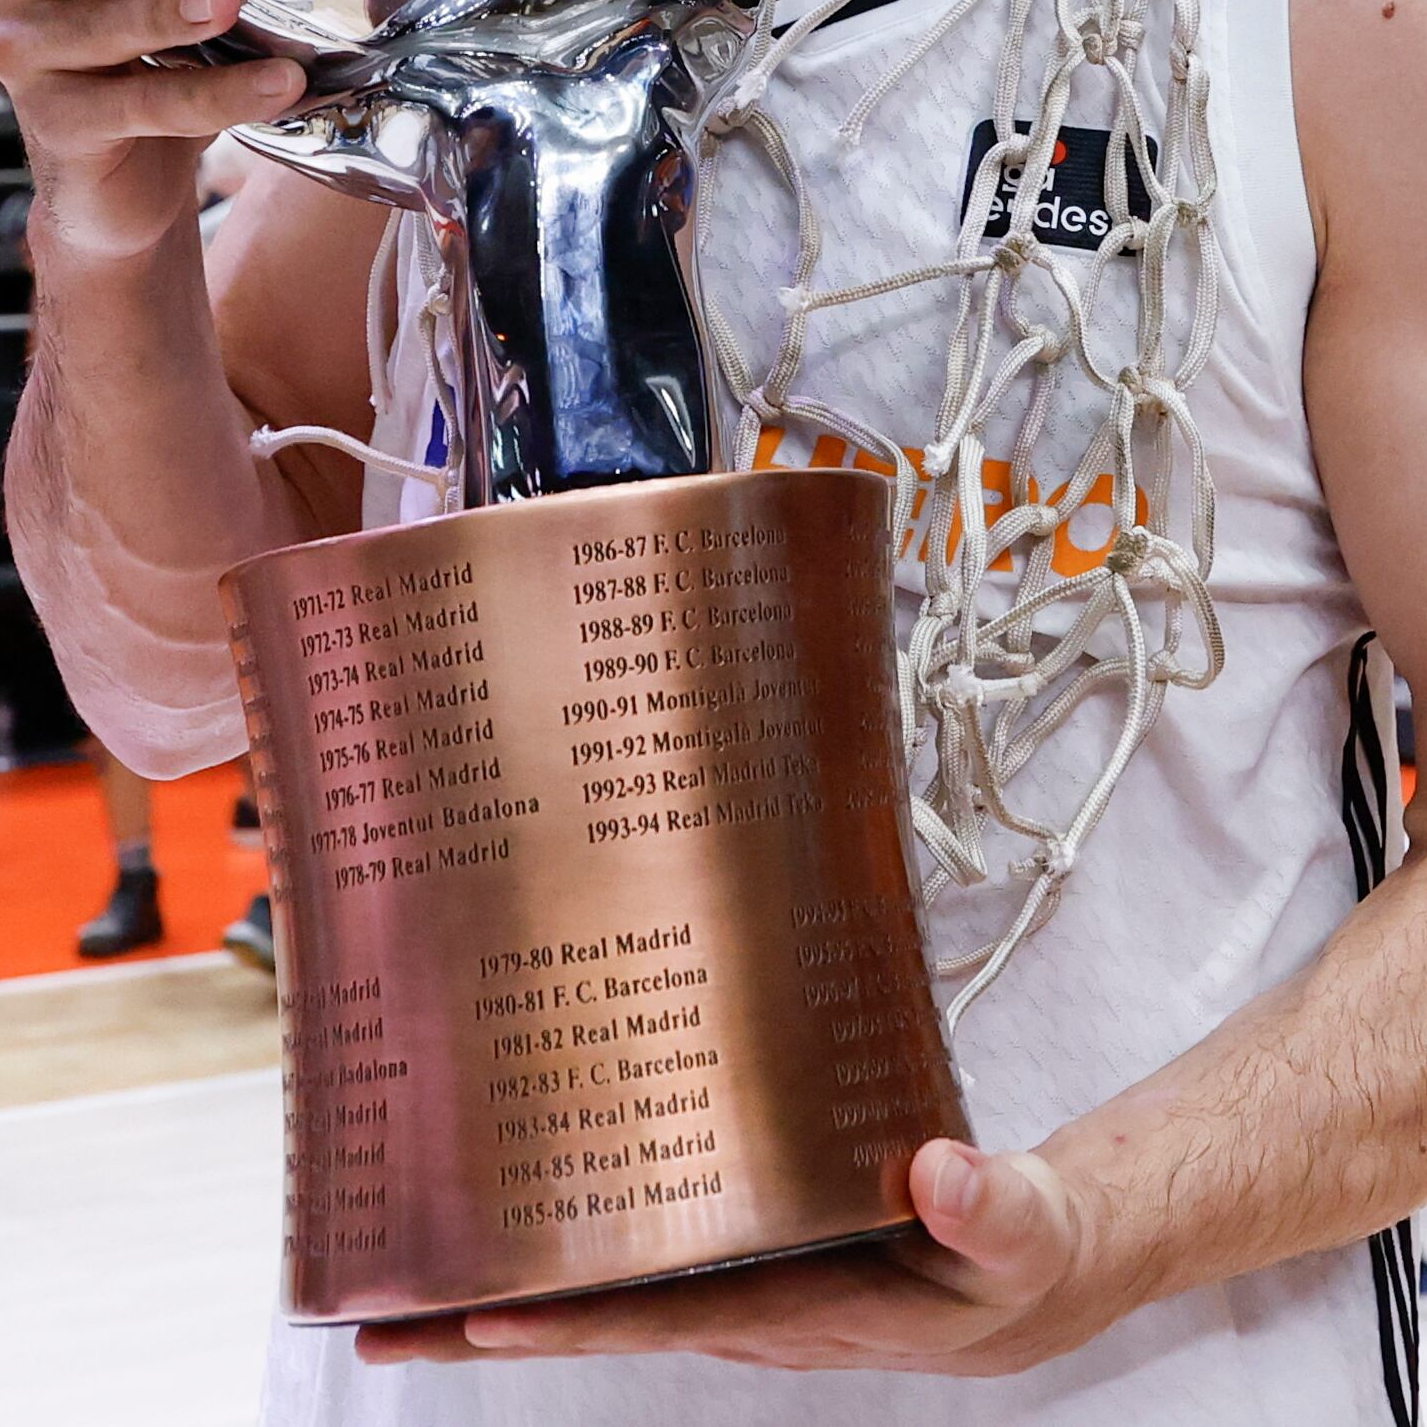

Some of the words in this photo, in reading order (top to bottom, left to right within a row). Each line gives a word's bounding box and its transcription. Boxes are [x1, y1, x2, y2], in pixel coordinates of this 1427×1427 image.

[572, 537, 647, 565] 1986-87
[701, 523, 786, 549] Barcelona
[293, 588, 345, 620] 1971-72
[352, 582, 391, 610] Real
[399, 562, 472, 594] Madrid
[573, 576, 647, 605] 1987-88
[702, 563, 790, 589] Barcelona
[300, 627, 353, 658] 1972-73
[359, 620, 398, 643] Real
[405, 602, 478, 632] Madrid
[579, 615, 653, 643] 1988-89
[708, 601, 792, 626] Barcelona
[307, 665, 360, 696] 1973-74
[366, 658, 403, 682] Real
[412, 642, 484, 671] Madrid
[583, 652, 658, 682] 1989-90
[711, 640, 796, 665] Barcelona
[314, 703, 364, 734] 1974-75
[370, 697, 409, 721] Real
[417, 679, 489, 711] Madrid
[562, 695, 638, 726] 1990-91
[320, 742, 370, 773] 1975-76
[376, 736, 414, 760] Real
[422, 718, 493, 750] Madrid
[571, 735, 647, 766] 1991-92
[325, 780, 376, 811] 1976-77
[382, 775, 421, 799] Real
[429, 757, 501, 789] Madrid
[582, 773, 656, 803] 1992-93
[663, 767, 705, 793] Real
[713, 756, 776, 785] Madrid
[310, 824, 357, 854] 1977-78
[442, 797, 540, 828] Badalona
[587, 812, 660, 844] 1993-94
[667, 805, 709, 831] Real
[716, 795, 780, 823] Madrid
[335, 860, 386, 890] 1978-79
[392, 853, 430, 879] Real
[438, 839, 510, 871] Madrid
[479, 946, 553, 979] 1979-80
[561, 937, 607, 965] Real
[615, 923, 691, 957] Madrid
[329, 977, 380, 1008] Madrid
[475, 990, 545, 1020] 1980-81
[605, 966, 708, 999] Barcelona
[332, 1018, 383, 1048] Madrid
[493, 1028, 563, 1059] 1981-82
[572, 1019, 618, 1047] Real
[626, 1005, 701, 1037] Madrid
[339, 1060, 407, 1087] Badalona
[488, 1071, 560, 1103] 1982-83
[618, 1048, 719, 1082] Barcelona
[335, 1100, 387, 1128] Madrid
[496, 1111, 571, 1144] 1983-84
[579, 1103, 624, 1131] Real
[633, 1087, 710, 1122] Madrid
[335, 1143, 385, 1169] Madrid
[500, 1153, 574, 1187] 1984-85
[583, 1145, 631, 1174] Real
[639, 1130, 716, 1164] Madrid
[335, 1184, 386, 1211] Madrid
[502, 1195, 578, 1228] 1985-86
[587, 1187, 635, 1217] Real
[644, 1171, 723, 1207] Madrid
[335, 1227, 386, 1252] Madrid
